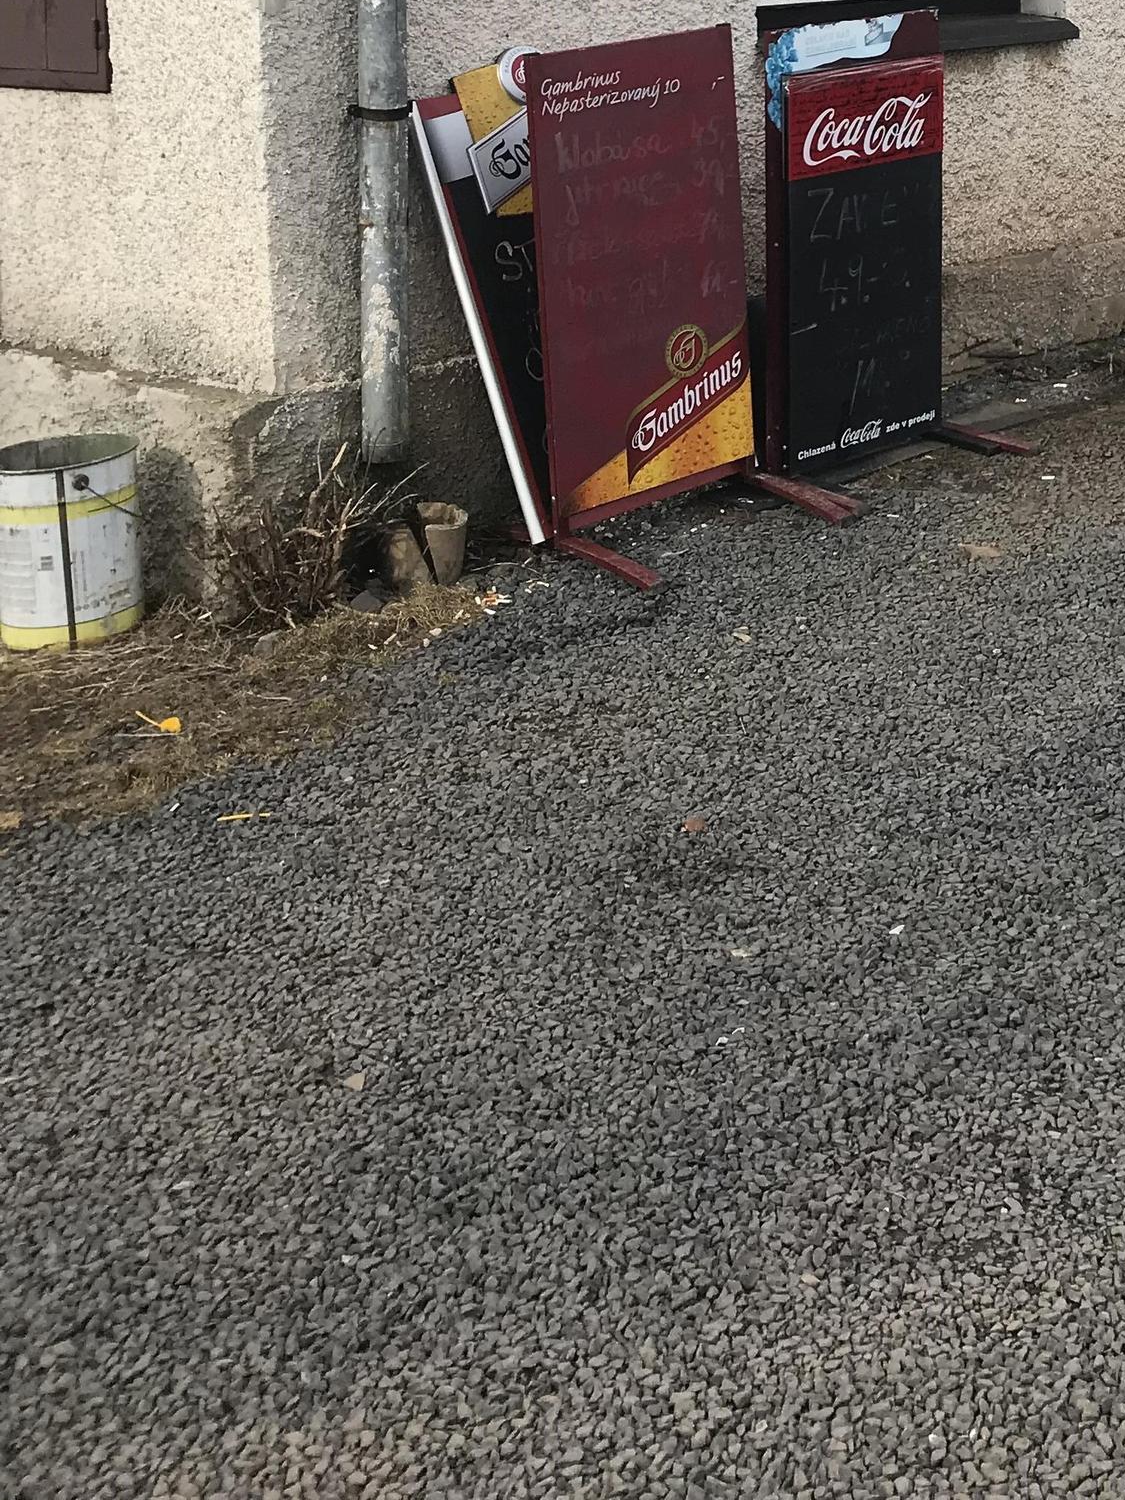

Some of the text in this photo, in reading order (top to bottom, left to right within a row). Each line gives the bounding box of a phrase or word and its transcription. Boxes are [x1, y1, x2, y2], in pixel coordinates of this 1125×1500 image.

[540, 70, 622, 100] Gambrinus
[541, 77, 662, 123] Nepasterizovaný
[663, 78, 681, 95] 10
[802, 91, 933, 167] Coca-Cola
[631, 350, 742, 452] Gambrinus
[797, 441, 836, 460] Chlazená
[886, 422, 900, 433] zde
[908, 409, 936, 428] prodeji
